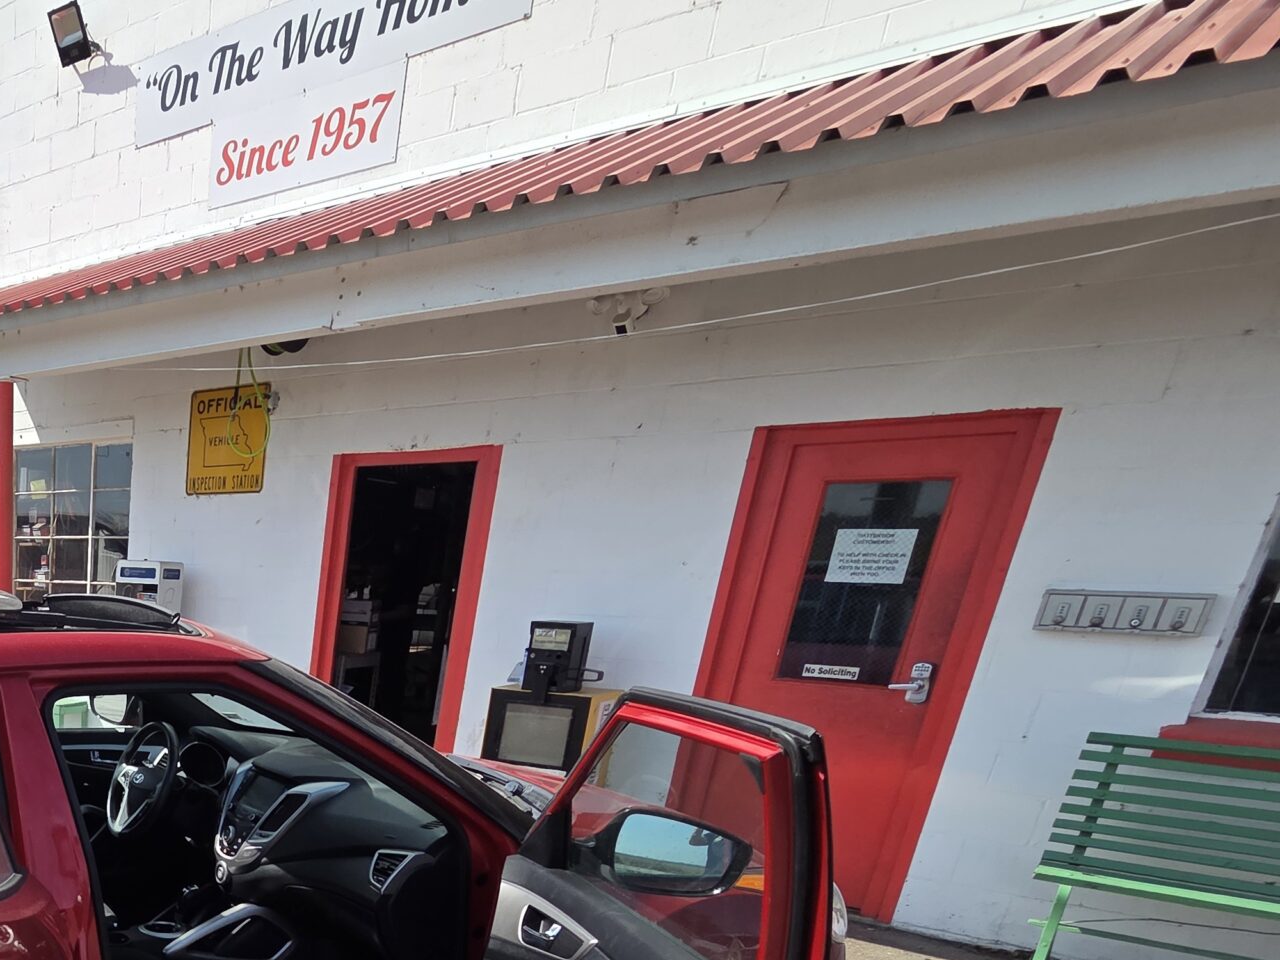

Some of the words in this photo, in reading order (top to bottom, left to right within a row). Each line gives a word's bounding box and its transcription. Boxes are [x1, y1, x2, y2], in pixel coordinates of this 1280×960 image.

[208, 40, 264, 95] The
[273, 7, 365, 71] Way
[216, 133, 300, 186] Since
[307, 90, 396, 162] 1957
[188, 475, 227, 492] INSPECTION
[231, 474, 261, 490] STATION
[804, 666, 816, 674] No
[817, 666, 857, 679] Soliciting
